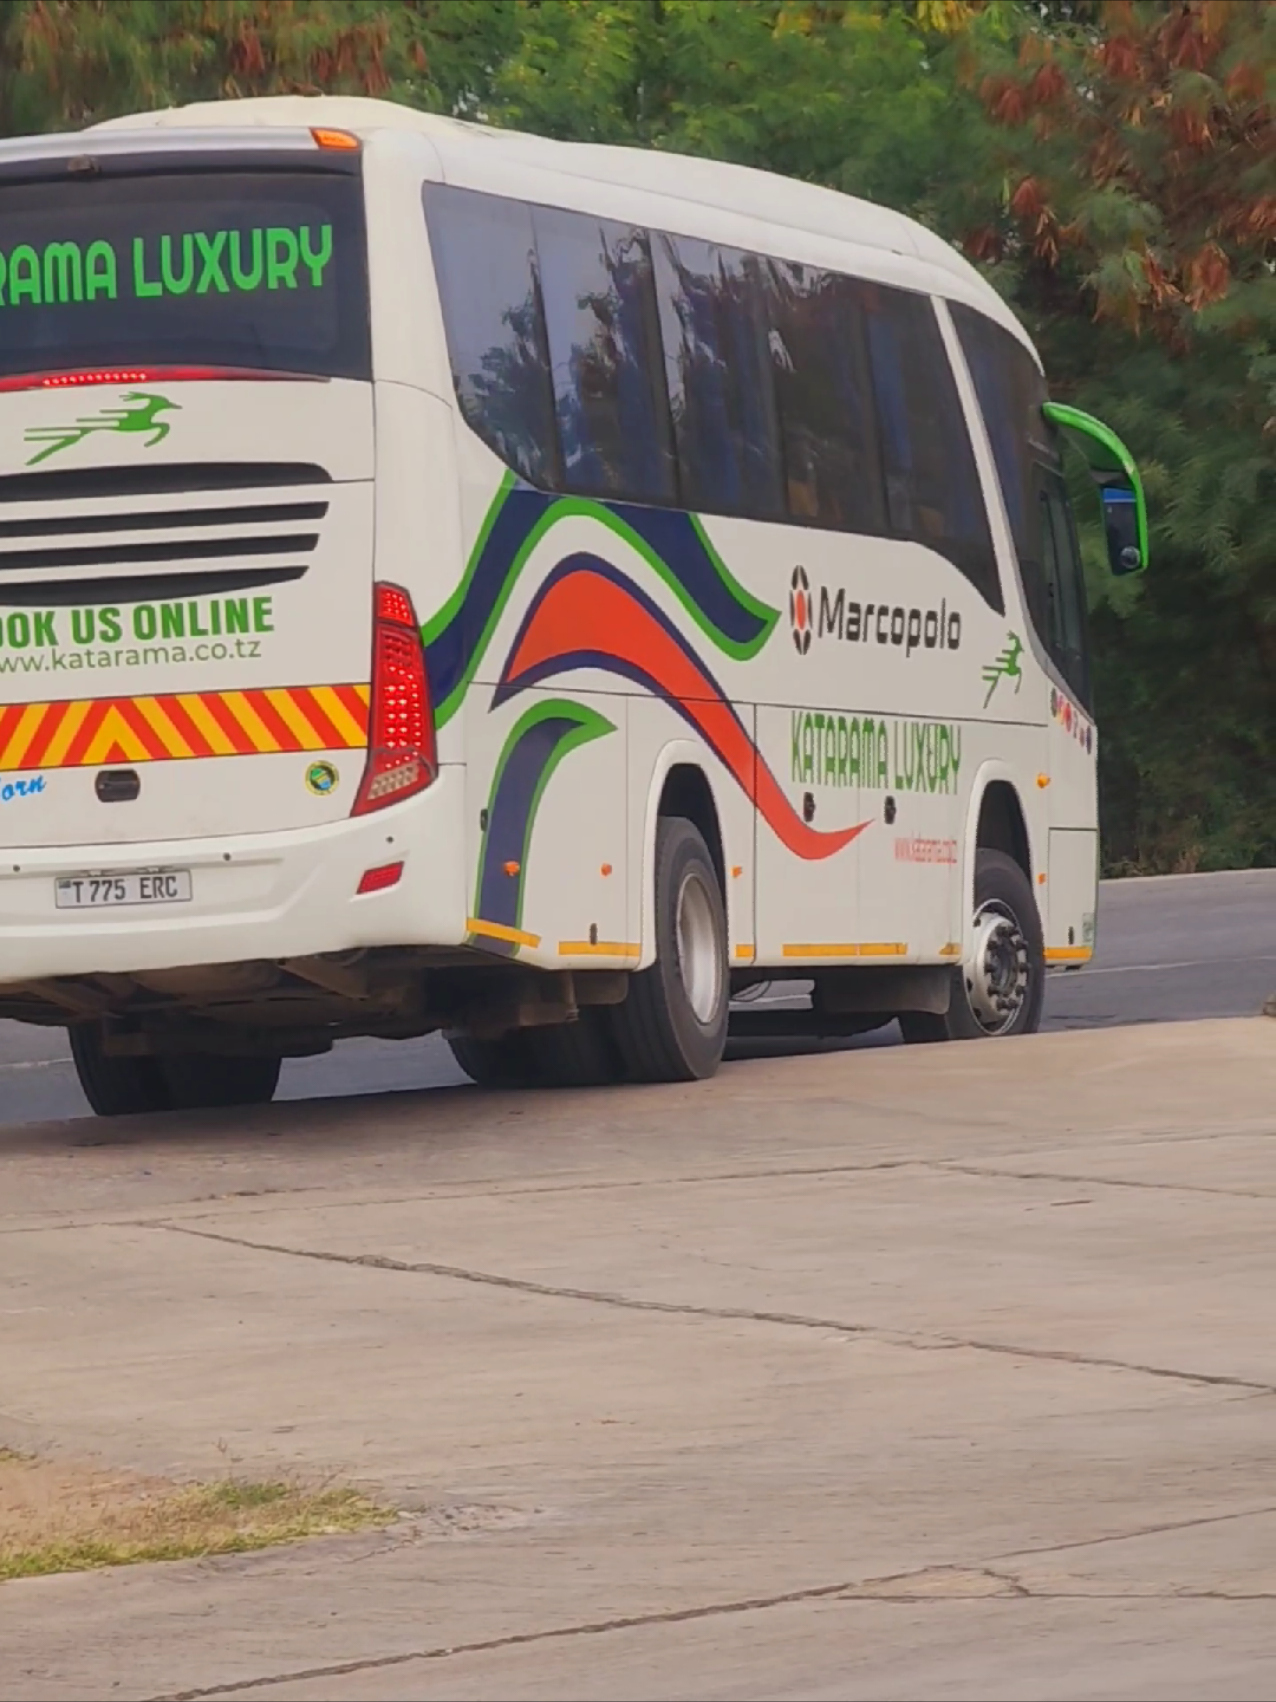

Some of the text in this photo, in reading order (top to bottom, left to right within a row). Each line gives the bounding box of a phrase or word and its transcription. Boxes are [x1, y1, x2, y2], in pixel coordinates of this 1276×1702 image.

[0, 225, 332, 306] AMA LUXURY
[0, 596, 275, 649] OK US ONLINE
[818, 586, 961, 658] Marcopolo
[791, 710, 889, 789] KATARAMA
[894, 720, 961, 796] LUXURY
[0, 774, 47, 801] orn
[72, 876, 177, 903] T 775 ERC
